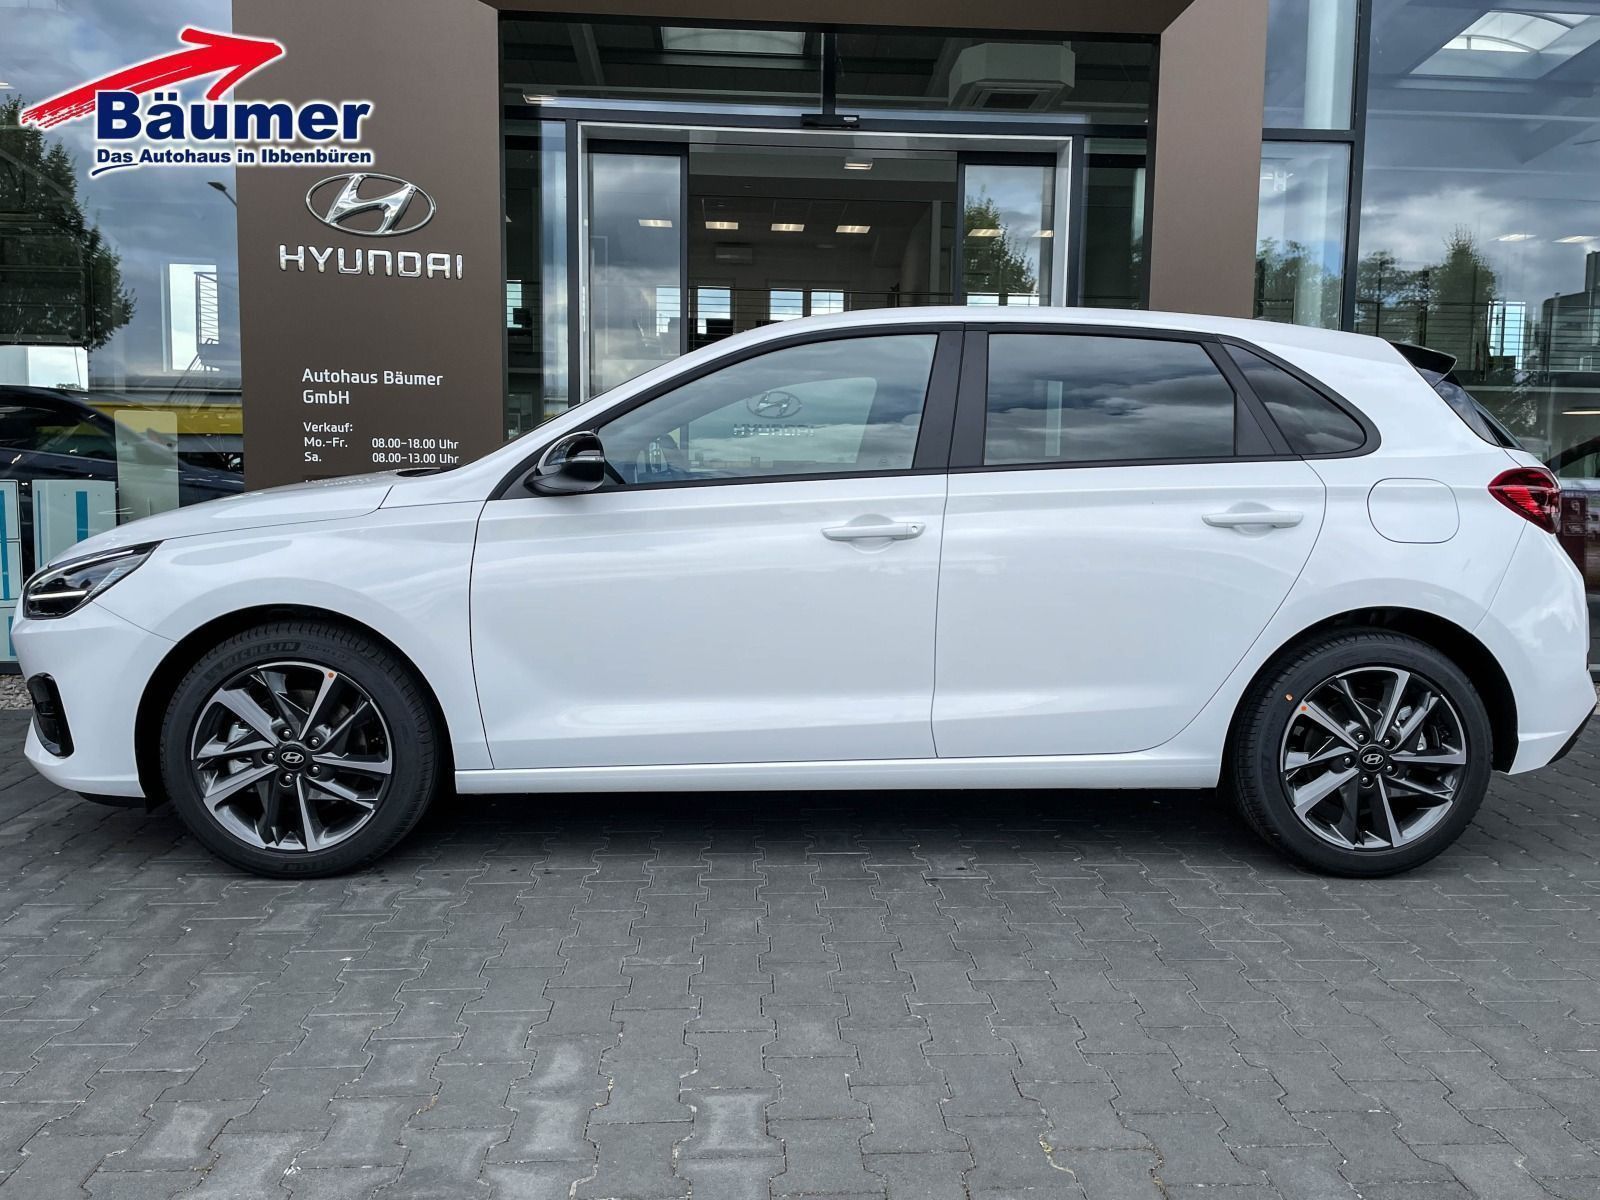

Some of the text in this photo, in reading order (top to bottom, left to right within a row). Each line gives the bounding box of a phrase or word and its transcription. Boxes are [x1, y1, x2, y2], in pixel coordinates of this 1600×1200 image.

[279, 244, 464, 280] HYUNDAI
[302, 368, 443, 386] Autohaus Bäumer
[302, 390, 350, 405] GmbH
[303, 422, 353, 433] Verkauf:
[439, 439, 459, 450] Uhr
[304, 452, 322, 462] Sa.
[439, 454, 459, 464] Uhr
